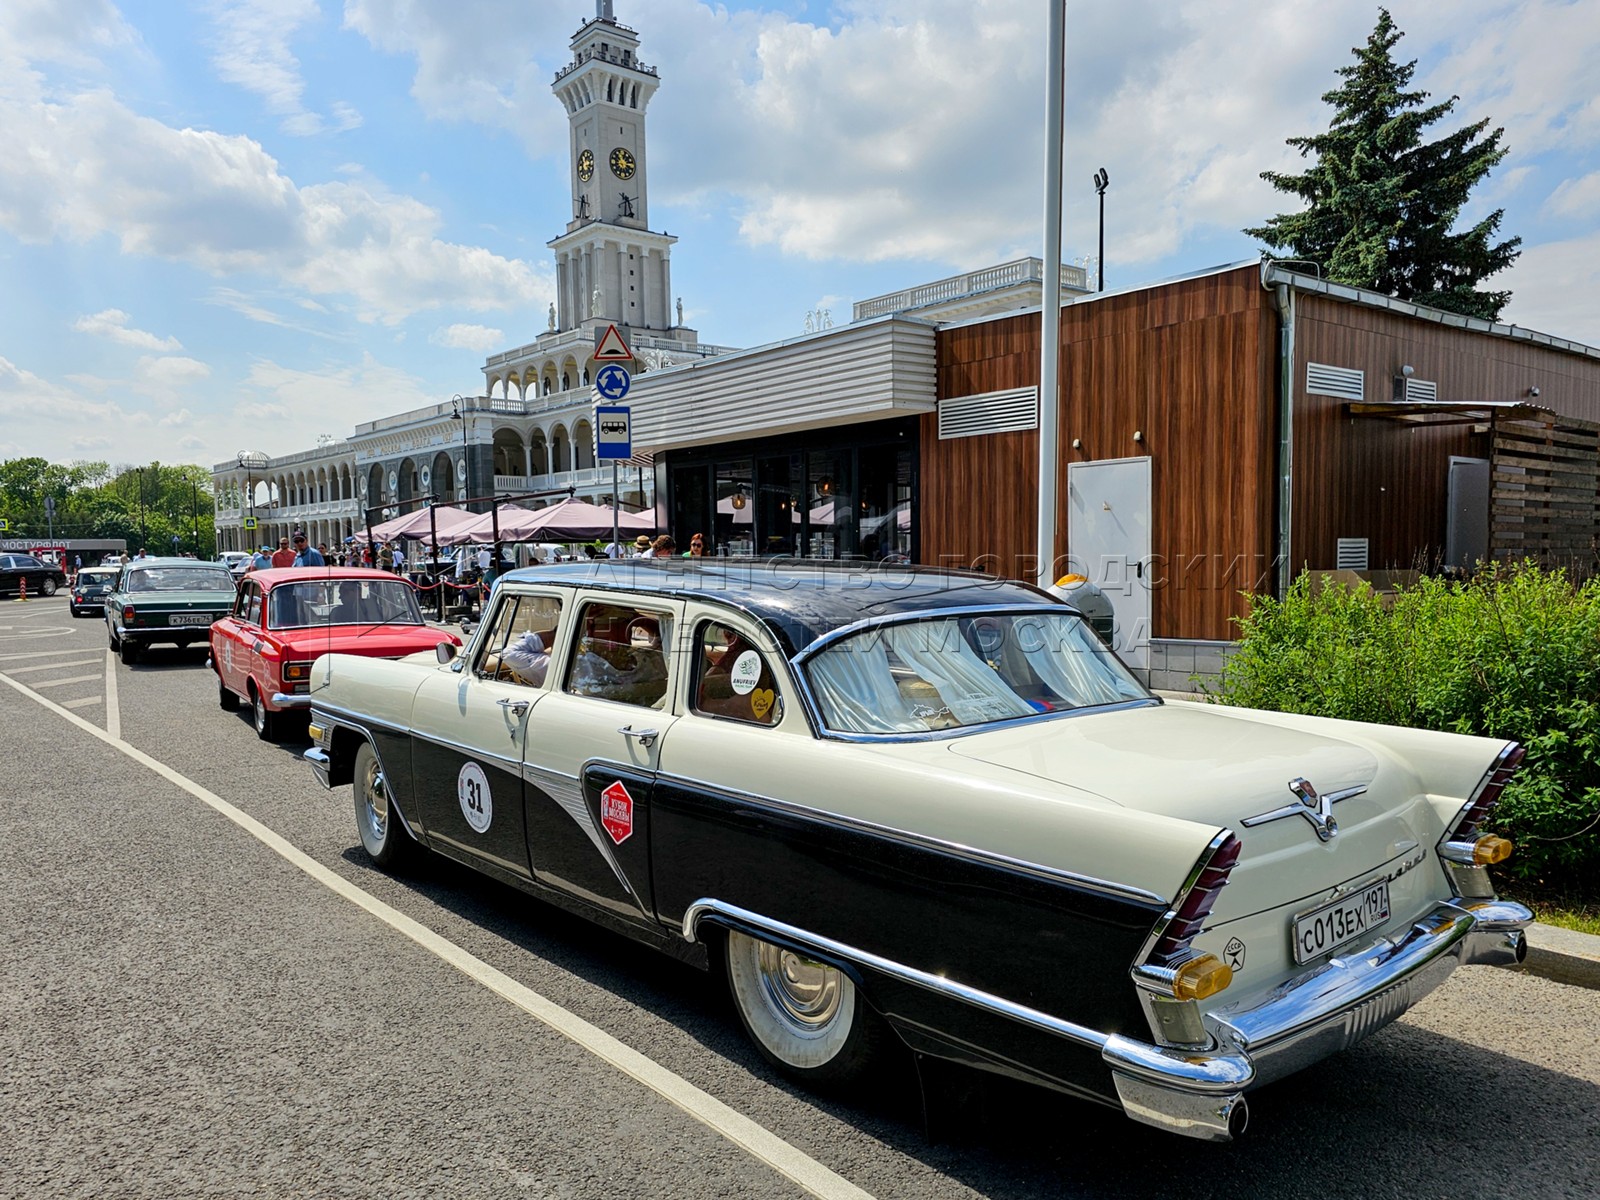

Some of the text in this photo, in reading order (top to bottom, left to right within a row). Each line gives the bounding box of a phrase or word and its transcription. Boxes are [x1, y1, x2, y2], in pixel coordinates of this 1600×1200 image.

[467, 778, 484, 815] 31
[1303, 886, 1384, 954] С013ЕХ 197
[1370, 912, 1382, 924] RUS
